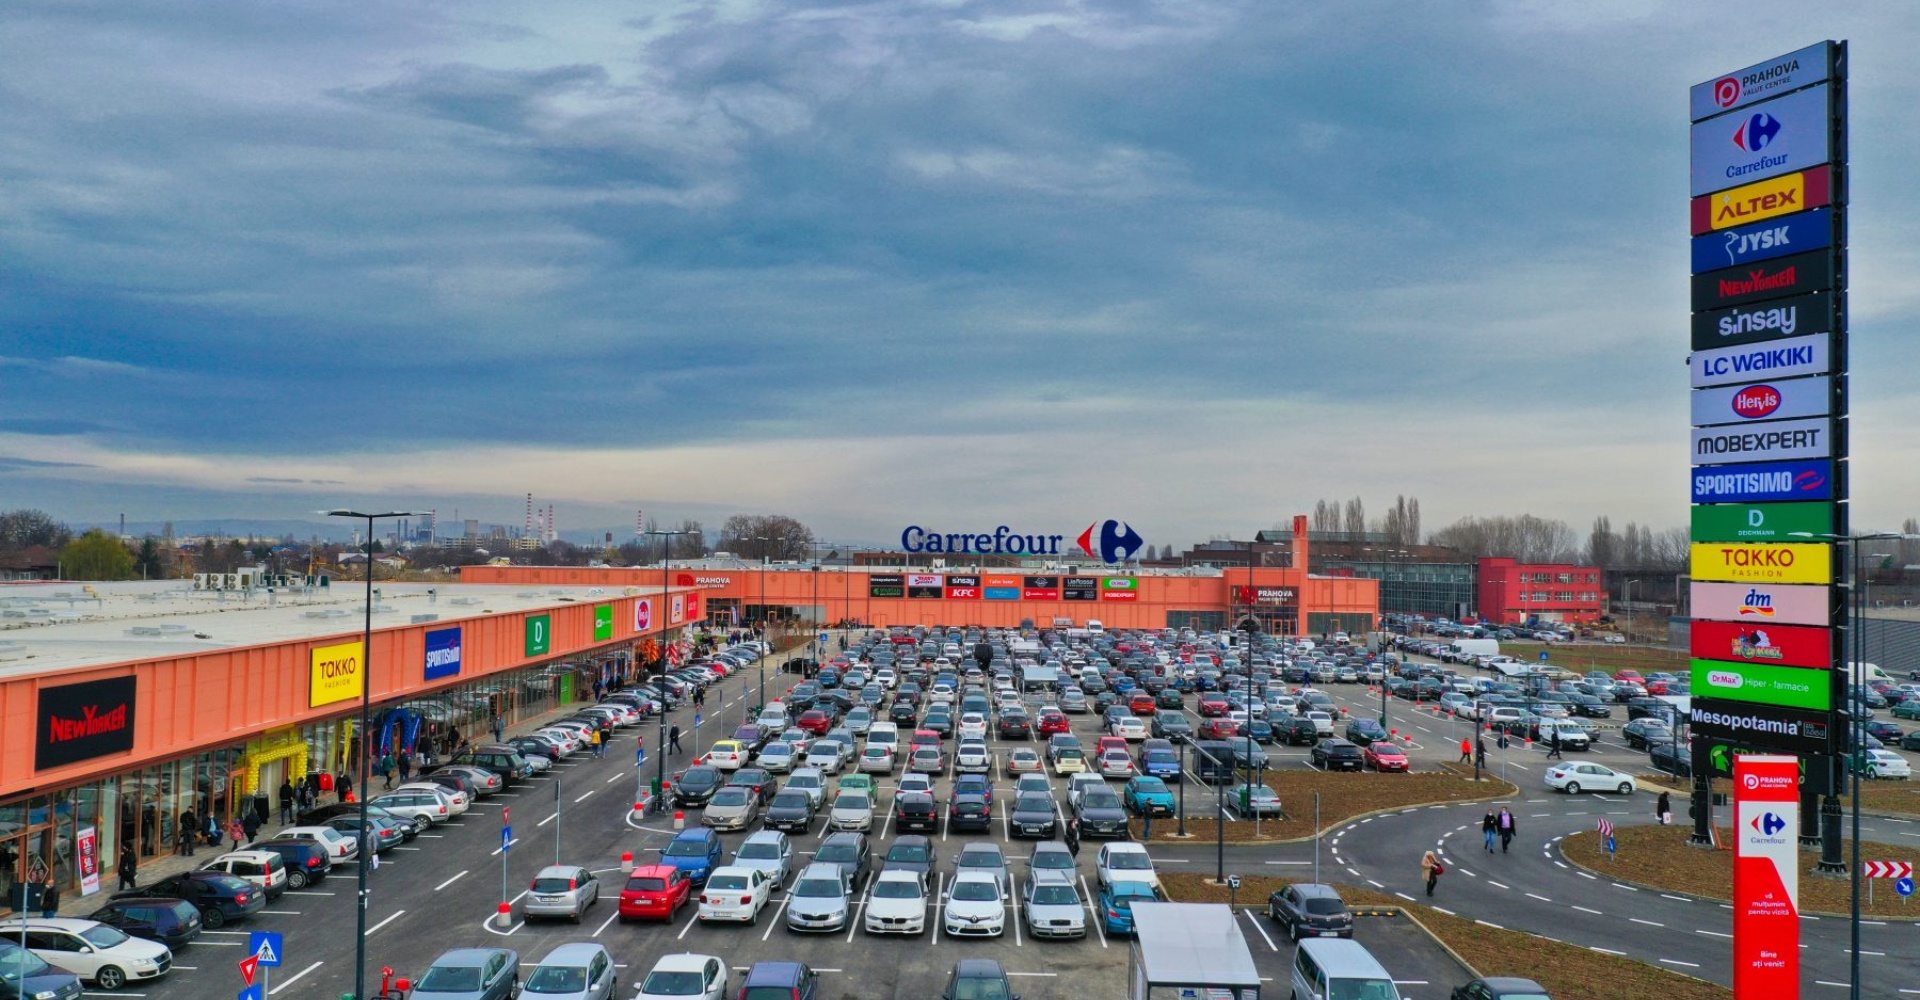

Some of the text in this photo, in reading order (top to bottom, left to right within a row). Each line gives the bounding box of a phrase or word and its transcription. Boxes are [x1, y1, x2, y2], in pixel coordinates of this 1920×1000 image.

[1742, 59, 1799, 87] PRAHOVA
[1743, 76, 1792, 97] VALUE CENTRE
[1726, 153, 1788, 178] Carrefour
[1738, 225, 1790, 254] JYSK
[1718, 306, 1796, 336] sinsay
[1704, 357, 1728, 377] LC
[1737, 392, 1777, 410] Hervis
[1695, 471, 1792, 495] SPORTISIMO
[1748, 509, 1764, 527] D
[901, 525, 1063, 554] Carrefour
[951, 577, 975, 586] sinsay
[1732, 569, 1782, 577] FASHION
[952, 589, 974, 597] KFC
[1745, 589, 1771, 606] dm
[535, 621, 543, 643] D
[1712, 674, 1736, 684] Dr.Max
[1745, 677, 1766, 688] Hiper
[1774, 680, 1809, 692] farmacie
[1760, 776, 1793, 784] PRAHOVA
